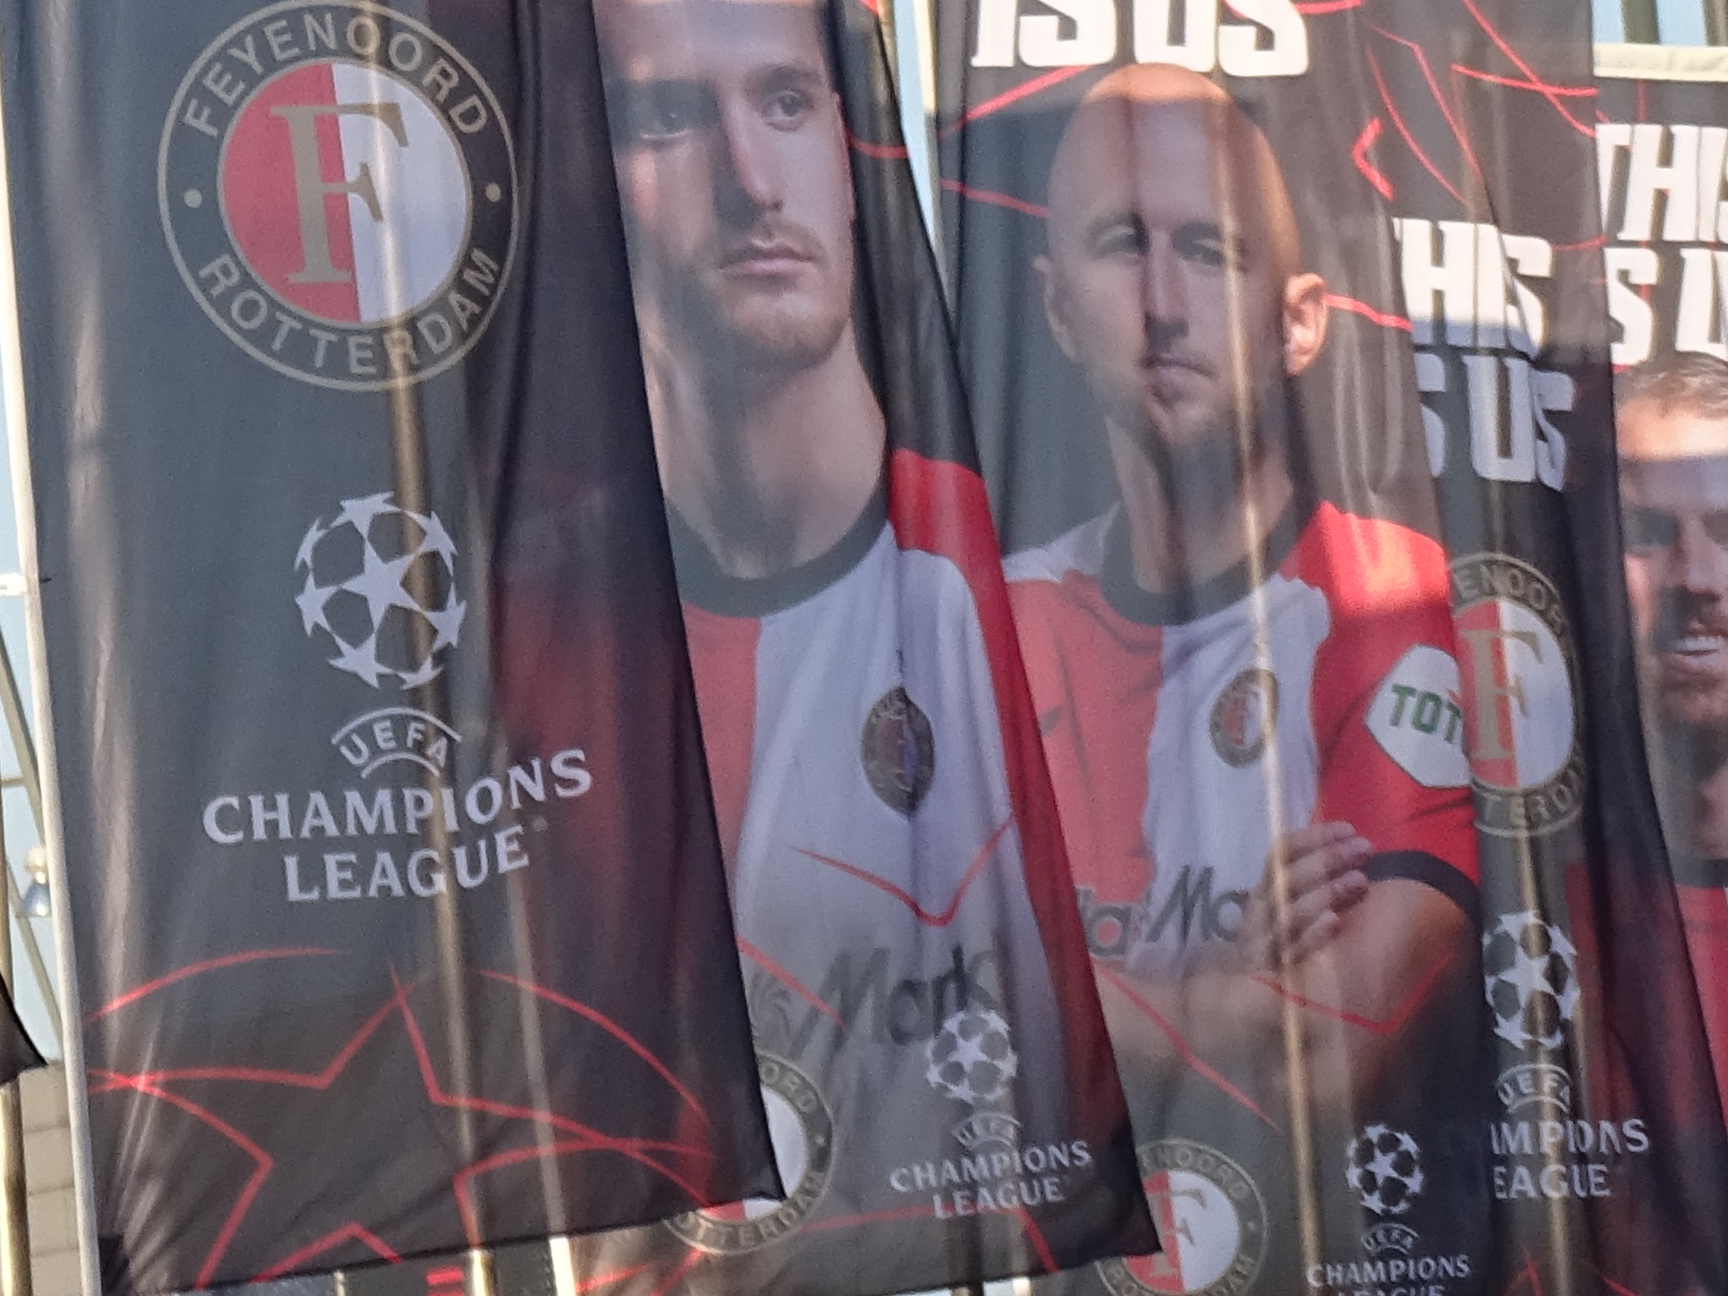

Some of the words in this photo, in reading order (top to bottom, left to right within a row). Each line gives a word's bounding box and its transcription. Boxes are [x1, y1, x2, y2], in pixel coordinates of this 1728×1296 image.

[184, 12, 487, 137] FEYENOORD
[269, 102, 409, 284] F
[199, 247, 500, 374] ROTTERDAM
[1392, 217, 1553, 360] HIS
[340, 718, 448, 768] UEFA
[1391, 683, 1462, 744] TOT
[202, 749, 592, 845] CHAMPIONS
[284, 825, 529, 902] LEAGUE
[889, 1140, 1092, 1193] CHAMPIONS
[932, 1177, 1064, 1219] LEAGUE
[1494, 1164, 1611, 1200] EAGUE
[1306, 1254, 1471, 1288] CHAMPIONS
